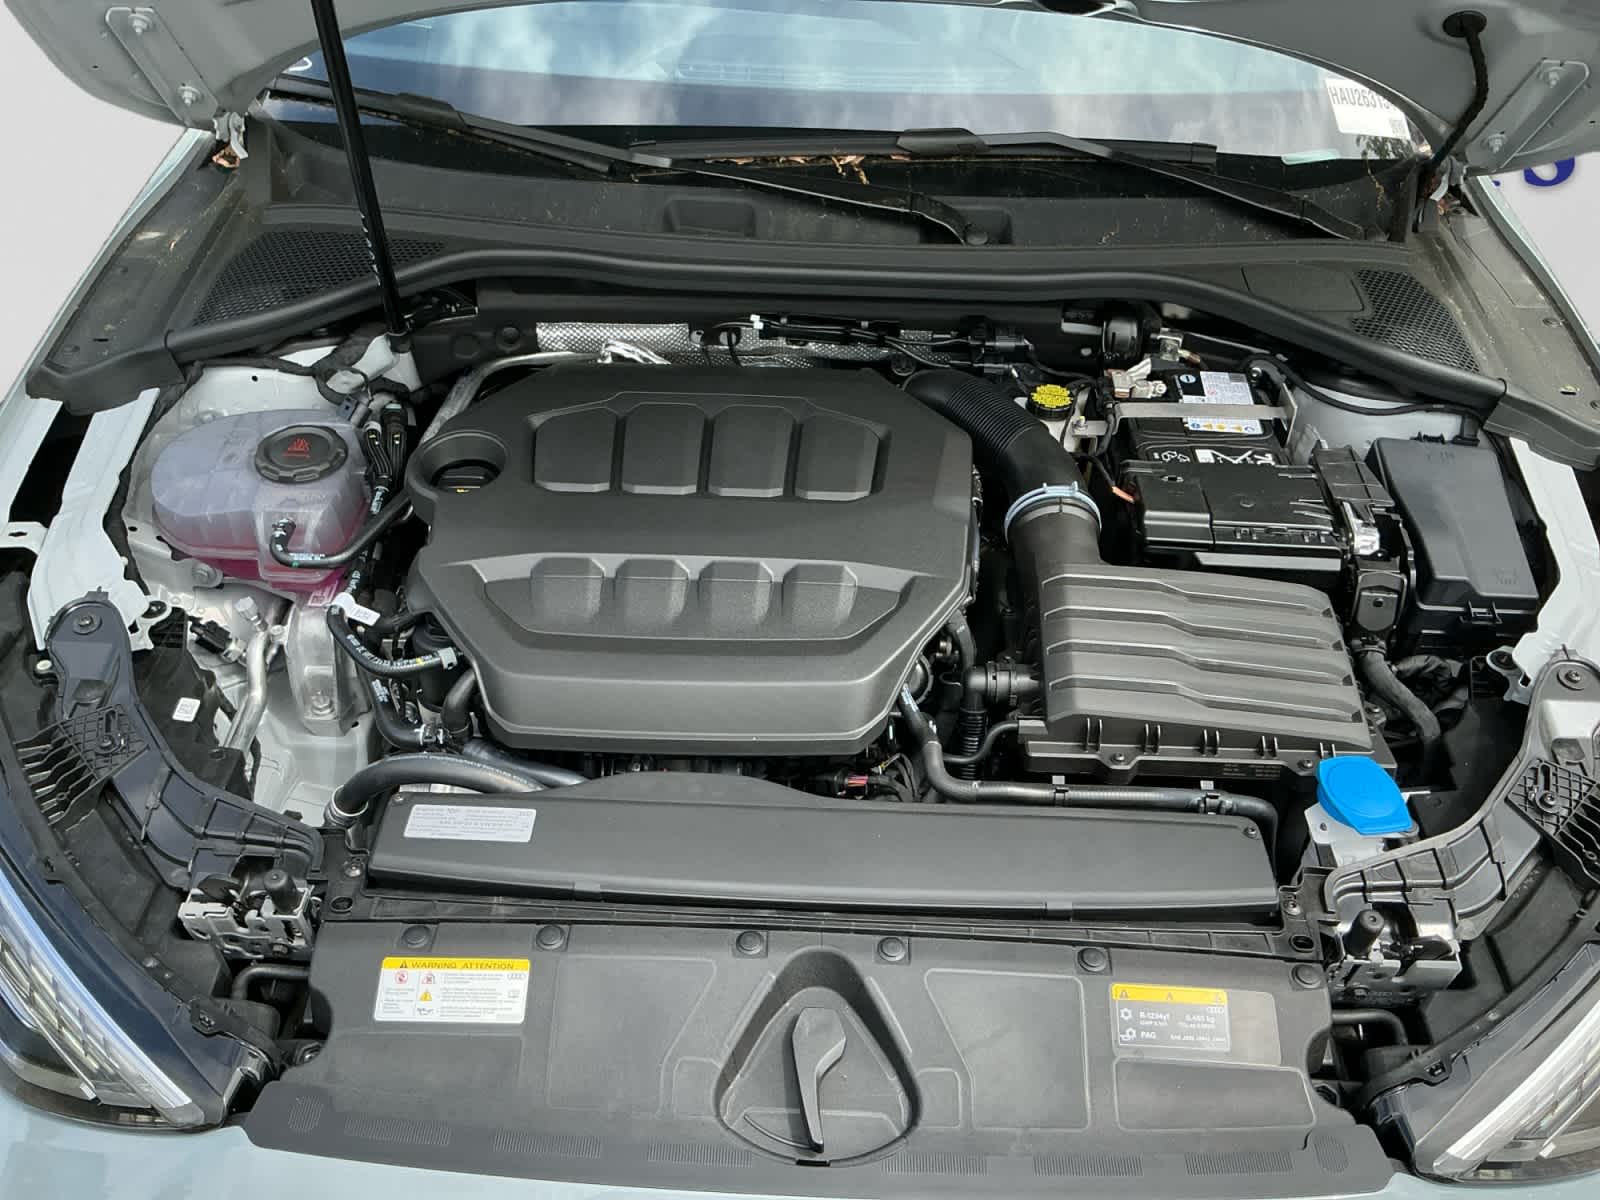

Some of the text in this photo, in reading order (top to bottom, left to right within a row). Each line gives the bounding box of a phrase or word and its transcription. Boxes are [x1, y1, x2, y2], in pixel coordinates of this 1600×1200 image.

[411, 960, 514, 971] WARNING ATTENTION
[1140, 1031, 1157, 1040] PAG
